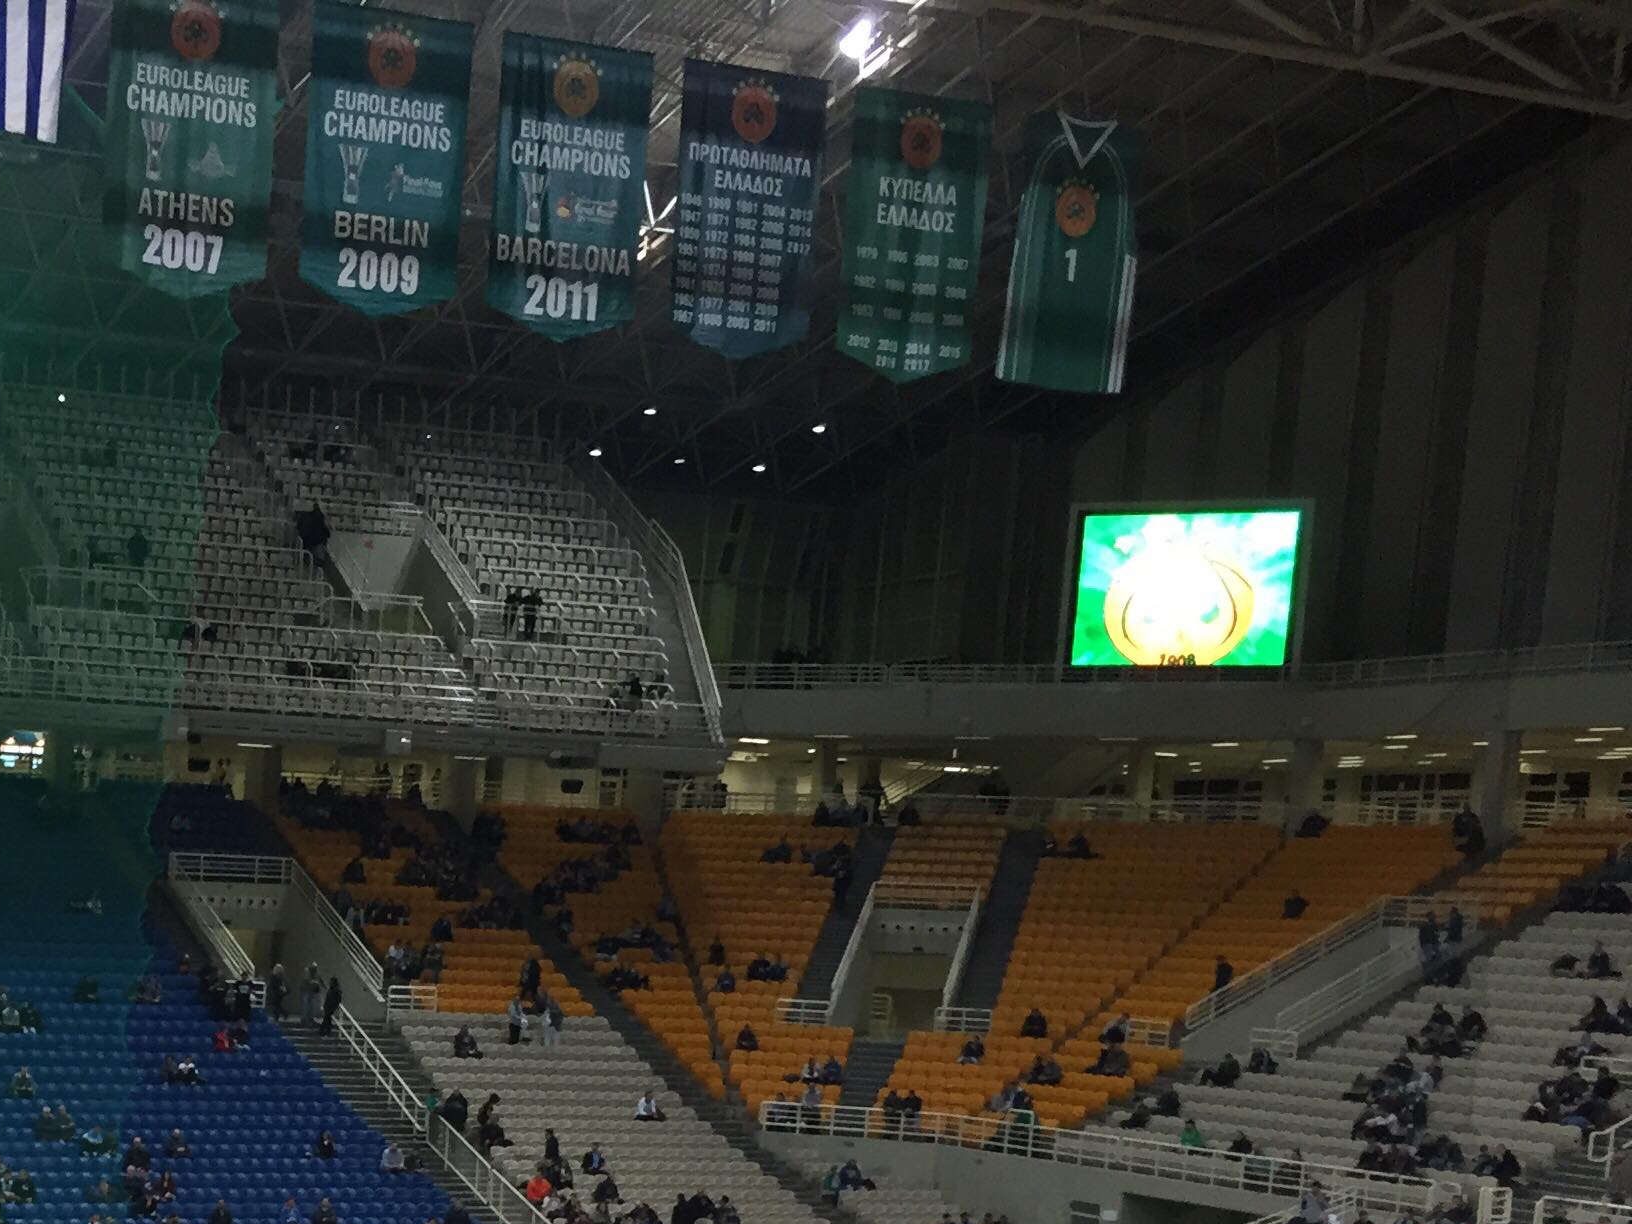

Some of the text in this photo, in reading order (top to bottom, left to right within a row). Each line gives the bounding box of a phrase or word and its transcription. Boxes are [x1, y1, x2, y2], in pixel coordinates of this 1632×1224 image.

[136, 62, 250, 99] EUROLEAGUE
[127, 84, 257, 128] CHAMPIONS
[334, 89, 445, 124] EUROLEAGUE
[324, 111, 451, 152] CHAMPIONS
[521, 119, 625, 153] EUROLEAGUE
[511, 141, 631, 179] CHAMPIONS
[689, 142, 812, 177] ΠΡΩΤΑΘΛΗΜΑΤΑ
[714, 169, 783, 197] ΕΛΛΑΔΟΣ
[879, 175, 957, 207] ΚΥΠΕΛΛΑ
[138, 187, 234, 228] ATHENS
[876, 203, 956, 233] ΕΛΛΑΔΟΣ
[334, 210, 429, 249] BERLIN
[142, 224, 223, 275] 2007
[496, 233, 630, 277] BARCELONA
[1065, 248, 1078, 283] 1
[337, 248, 419, 296] 2009
[523, 274, 599, 321] 2011
